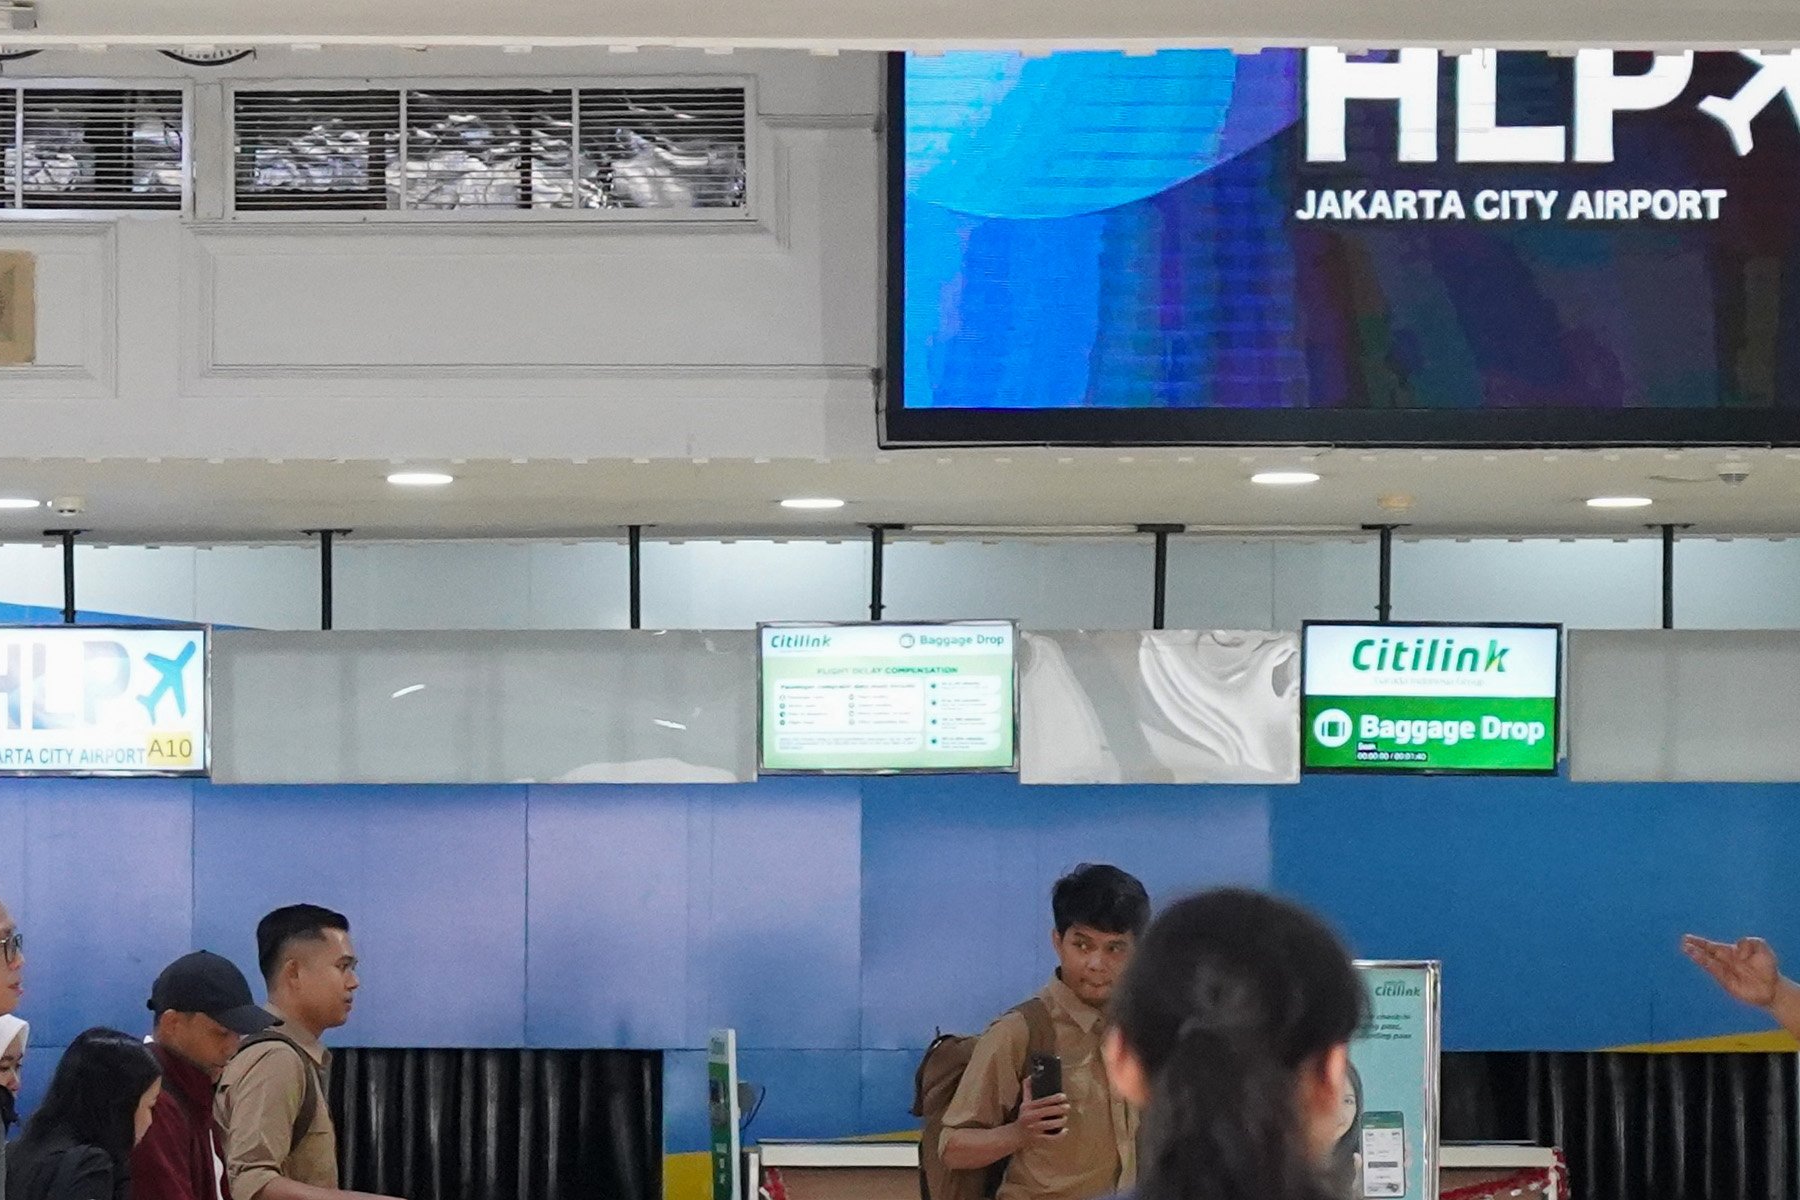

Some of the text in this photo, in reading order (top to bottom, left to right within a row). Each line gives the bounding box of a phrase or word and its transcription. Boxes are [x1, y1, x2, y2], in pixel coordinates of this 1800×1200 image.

[1305, 47, 1694, 162] HLP
[1296, 189, 1727, 221] JAKARTA CITY AIRPORT
[771, 635, 832, 649] Citilink
[919, 634, 1005, 648] Baggage Drop
[1352, 638, 1511, 672] Citilink
[1360, 714, 1546, 746] Baggage Drop
[40, 748, 74, 765] CITY
[79, 748, 146, 765] AIRPORT
[148, 738, 192, 758] A10
[1375, 985, 1422, 997] Citilink
